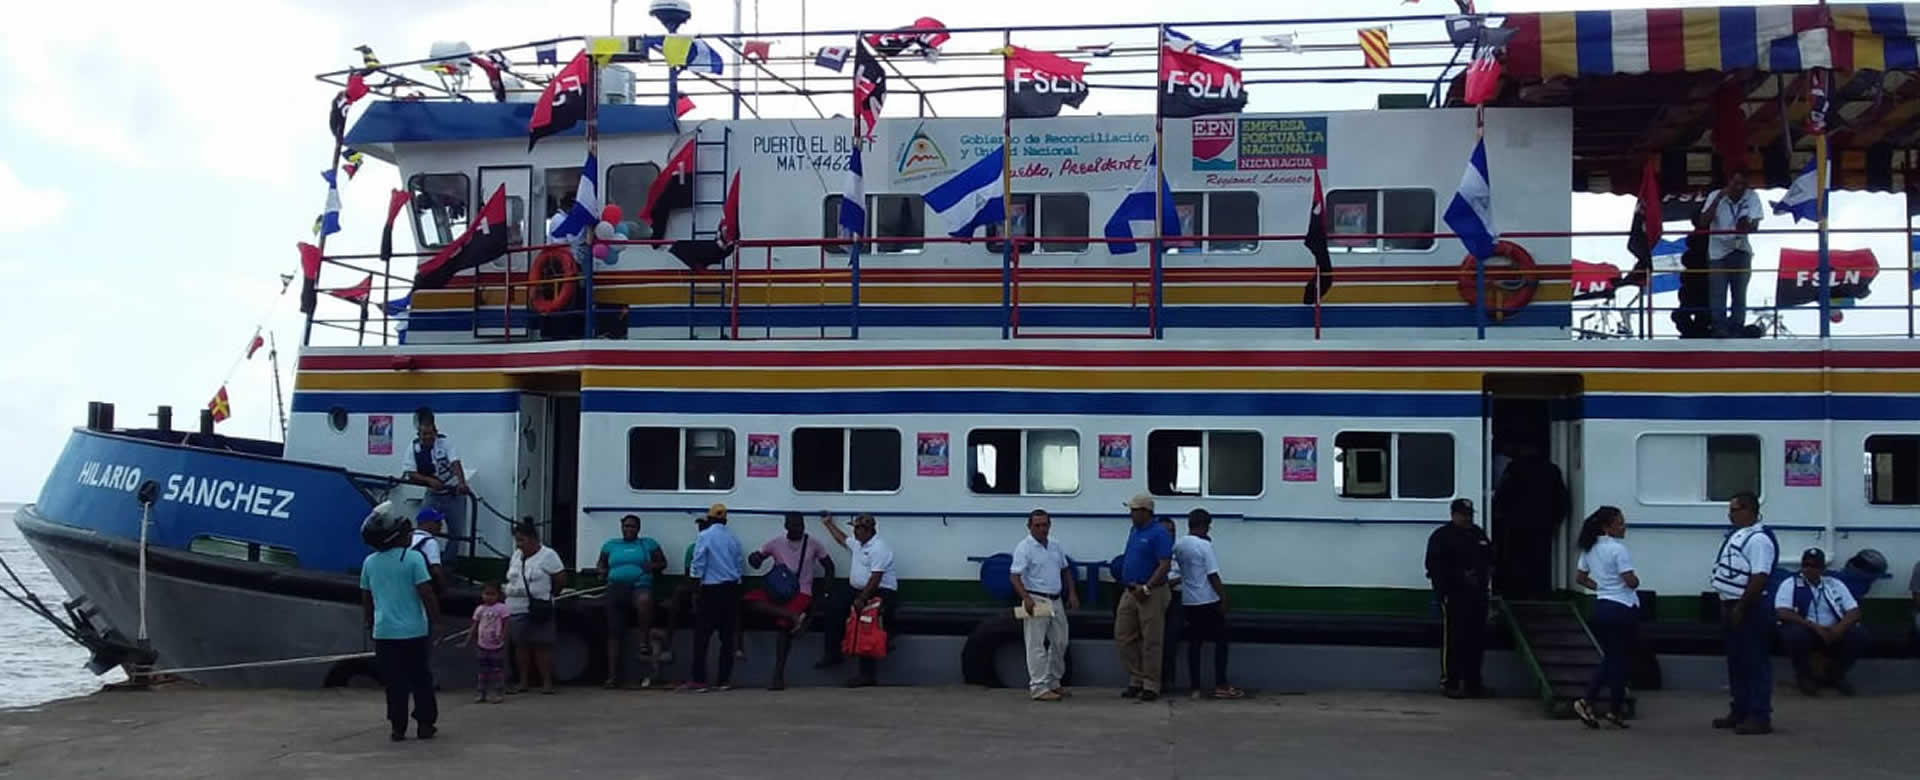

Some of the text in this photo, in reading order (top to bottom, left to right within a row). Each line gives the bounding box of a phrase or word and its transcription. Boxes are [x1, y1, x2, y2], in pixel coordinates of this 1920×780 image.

[1012, 67, 1087, 94] FSLN
[1166, 70, 1241, 99] FSLN
[1194, 121, 1233, 137] EPN
[753, 136, 806, 153] PUERTO
[811, 136, 828, 153] EL
[960, 134, 1020, 145] Gobiero
[1025, 134, 1040, 143] de
[960, 149, 969, 160] y
[1023, 145, 1079, 156] Nacional
[1009, 163, 1053, 178] ueblo,
[1241, 158, 1313, 169] NICARAGUA
[1796, 270, 1861, 287] FSLN
[1573, 280, 1607, 296] LN
[78, 461, 295, 519] HILARIO SANCHEZ
